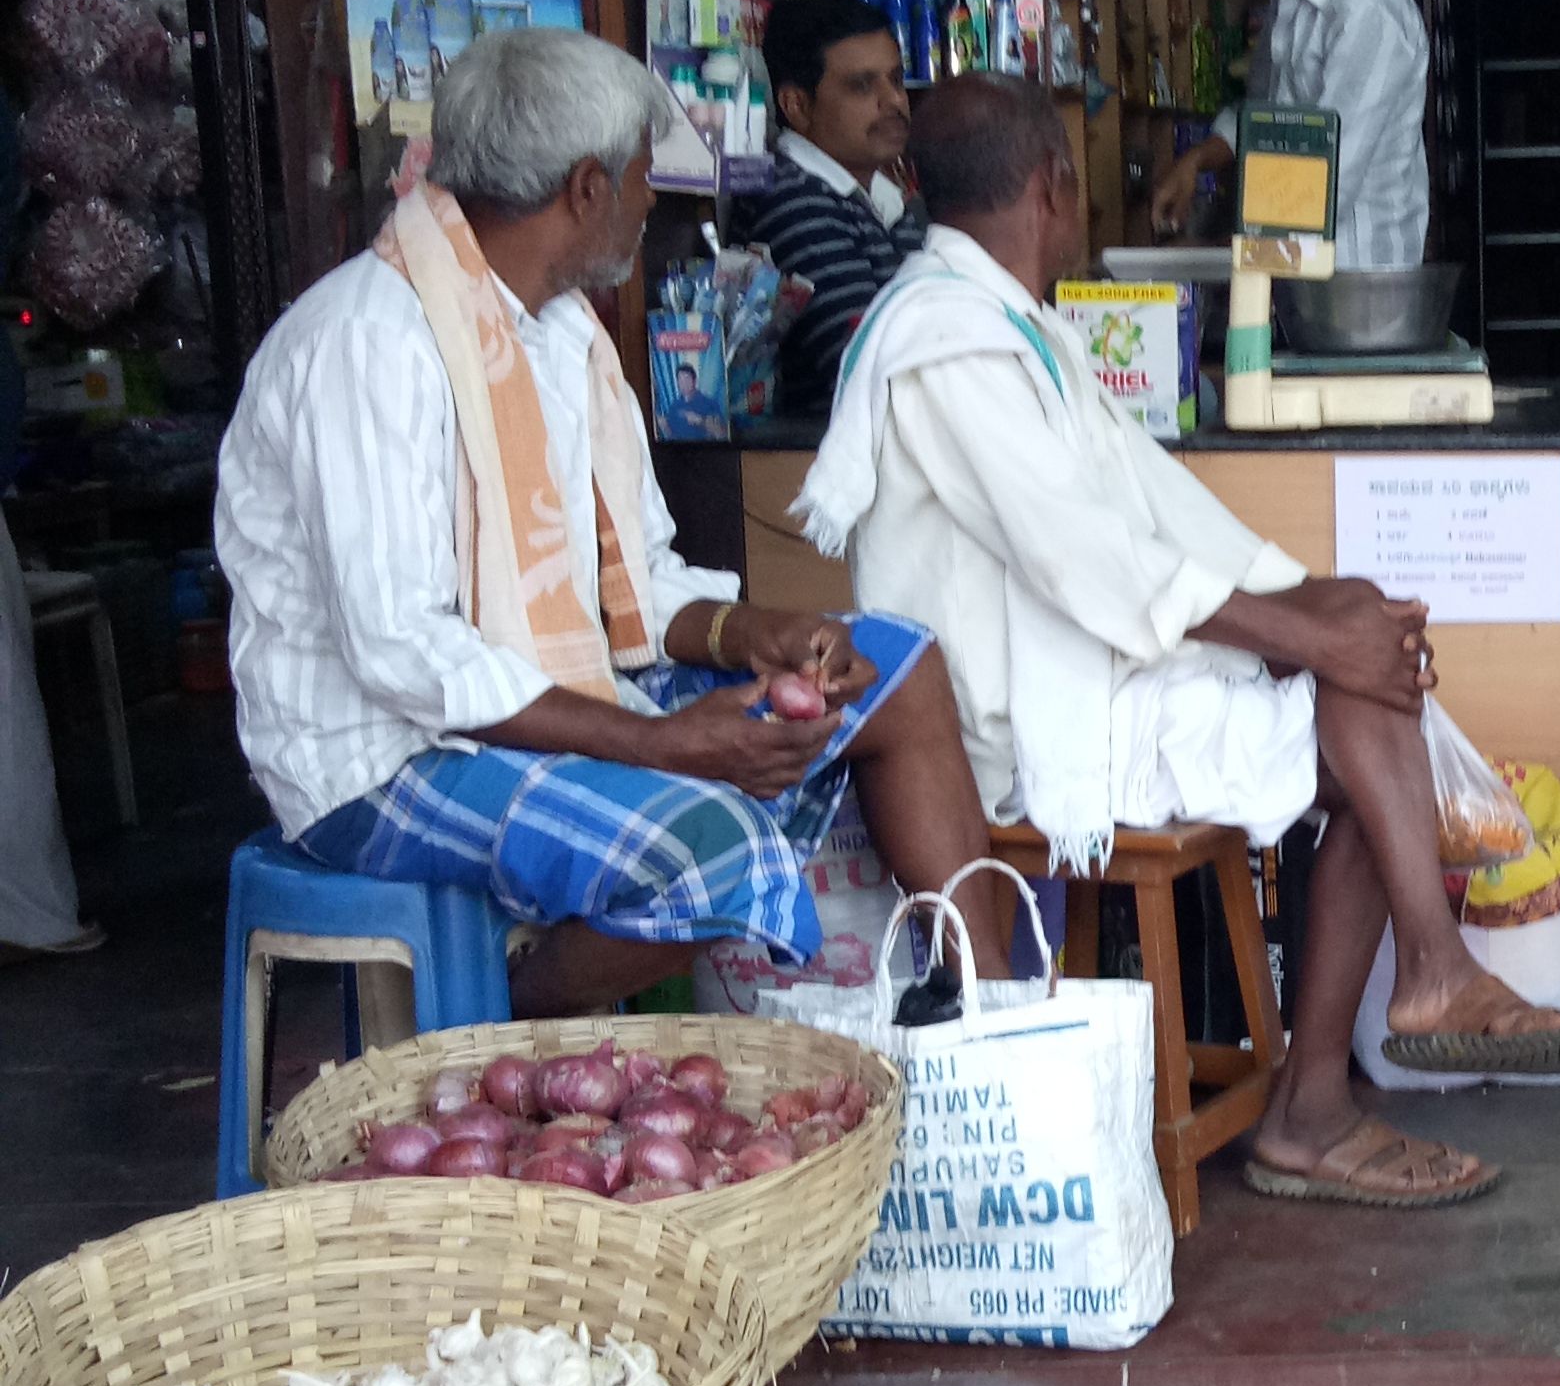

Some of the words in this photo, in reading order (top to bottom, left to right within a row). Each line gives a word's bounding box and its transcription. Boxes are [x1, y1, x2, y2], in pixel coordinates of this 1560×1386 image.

[963, 1117, 1017, 1145] PIN
[978, 1174, 1095, 1228] DCW
[1009, 1242, 1055, 1271] NET
[853, 1286, 892, 1312] LOT
[968, 1290, 1008, 1315] 065
[1016, 1289, 1045, 1312] PR
